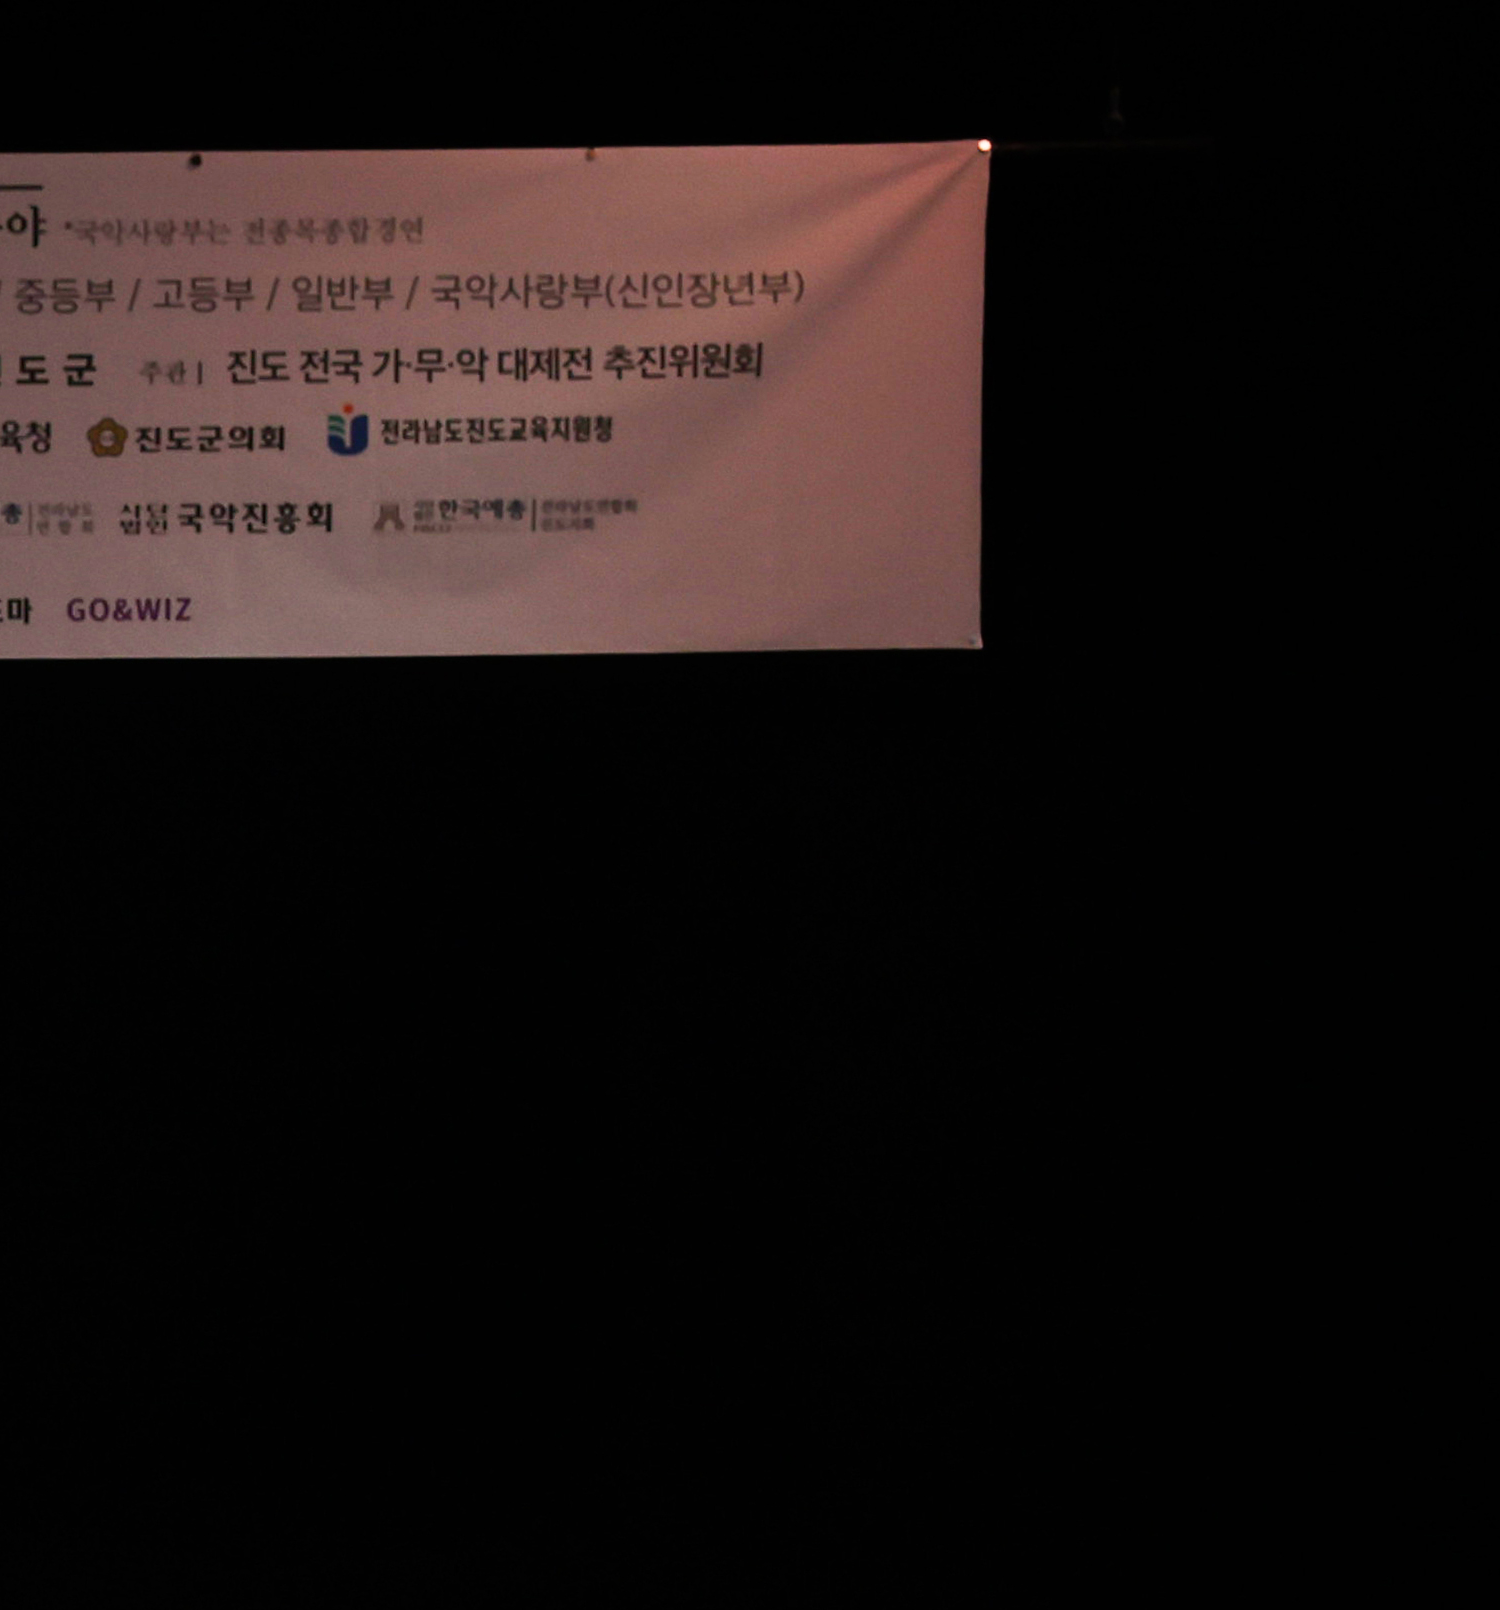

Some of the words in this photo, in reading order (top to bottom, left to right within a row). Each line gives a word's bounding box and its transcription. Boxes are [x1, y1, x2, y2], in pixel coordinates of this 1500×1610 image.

[14, 277, 116, 317] 중등부
[153, 276, 254, 314] 고등부
[291, 274, 395, 313] 일반부
[430, 270, 805, 312] 국악사랑부(신인장년부)
[227, 348, 290, 386] 진도
[299, 348, 363, 385] 전국
[497, 346, 593, 383] 대제전
[603, 341, 764, 381] 추진위원회
[135, 425, 286, 454] 진도군의회
[381, 414, 614, 447] 전라남도진도교육지원청
[178, 501, 333, 535] 국악진흥회
[66, 597, 192, 623] GO&WIZ
